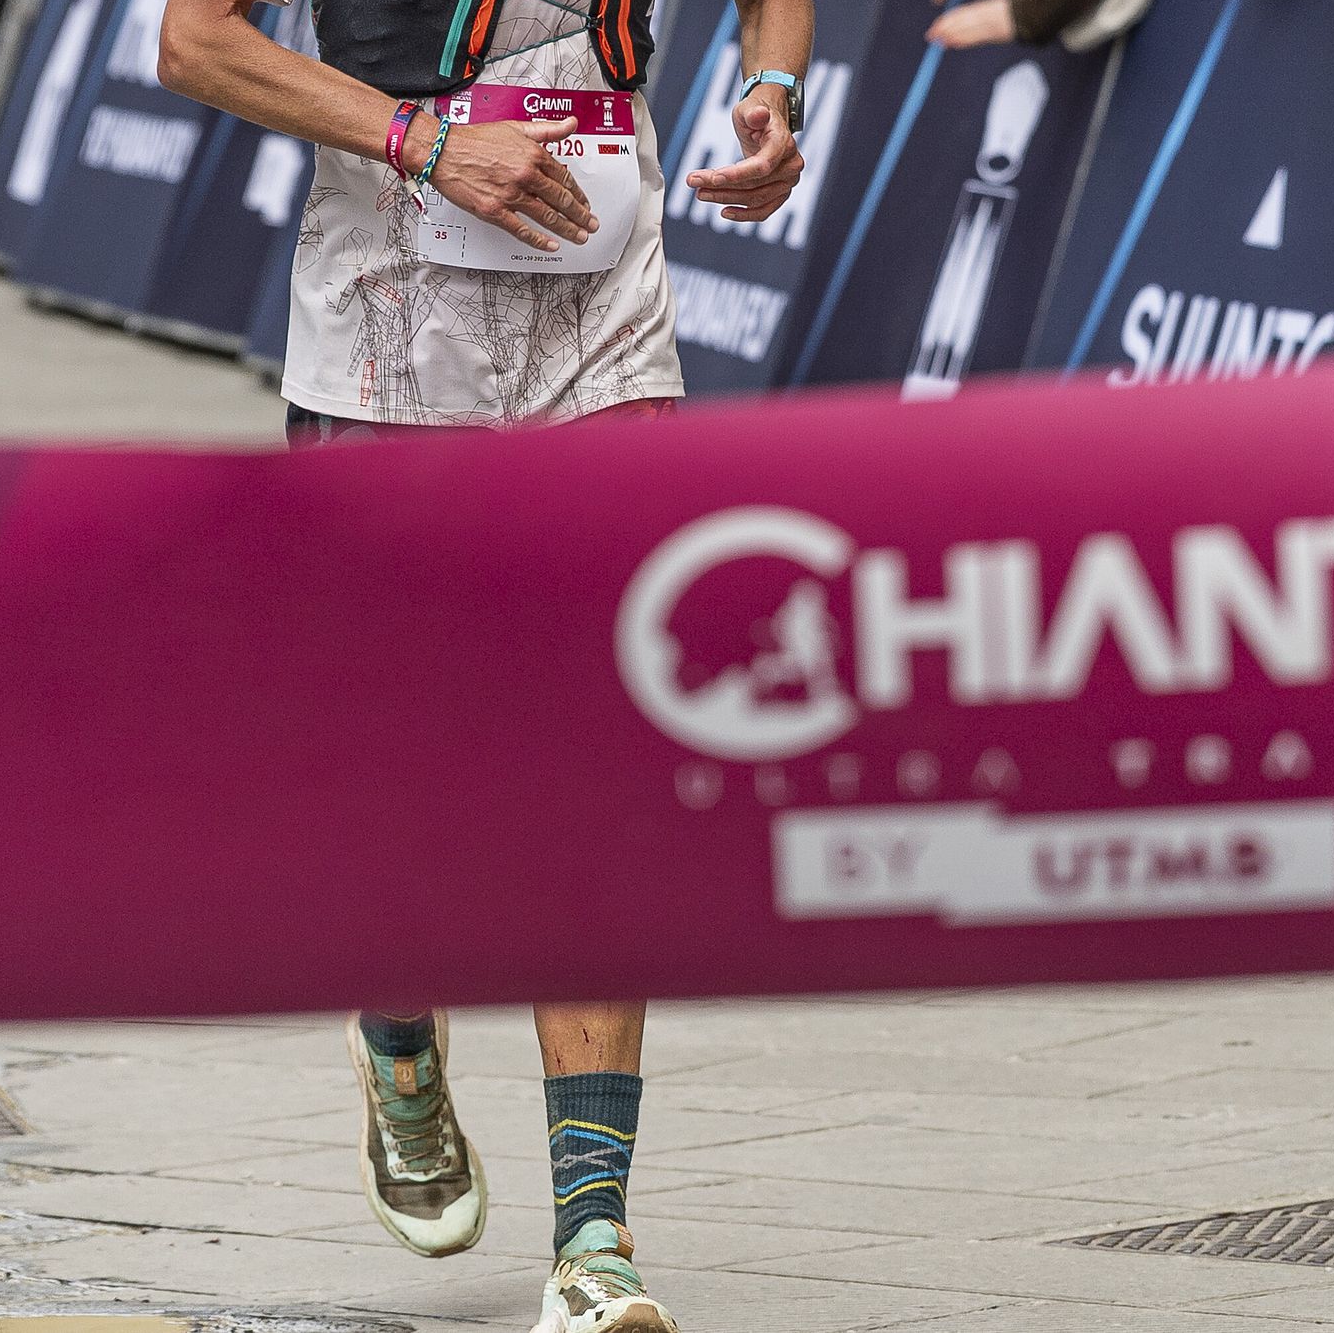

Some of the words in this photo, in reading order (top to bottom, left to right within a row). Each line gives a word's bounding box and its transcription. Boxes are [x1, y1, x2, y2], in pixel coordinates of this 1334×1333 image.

[523, 92, 573, 114] CHIANTI
[435, 230, 447, 240] 35
[1029, 832, 1281, 898] UTMB
